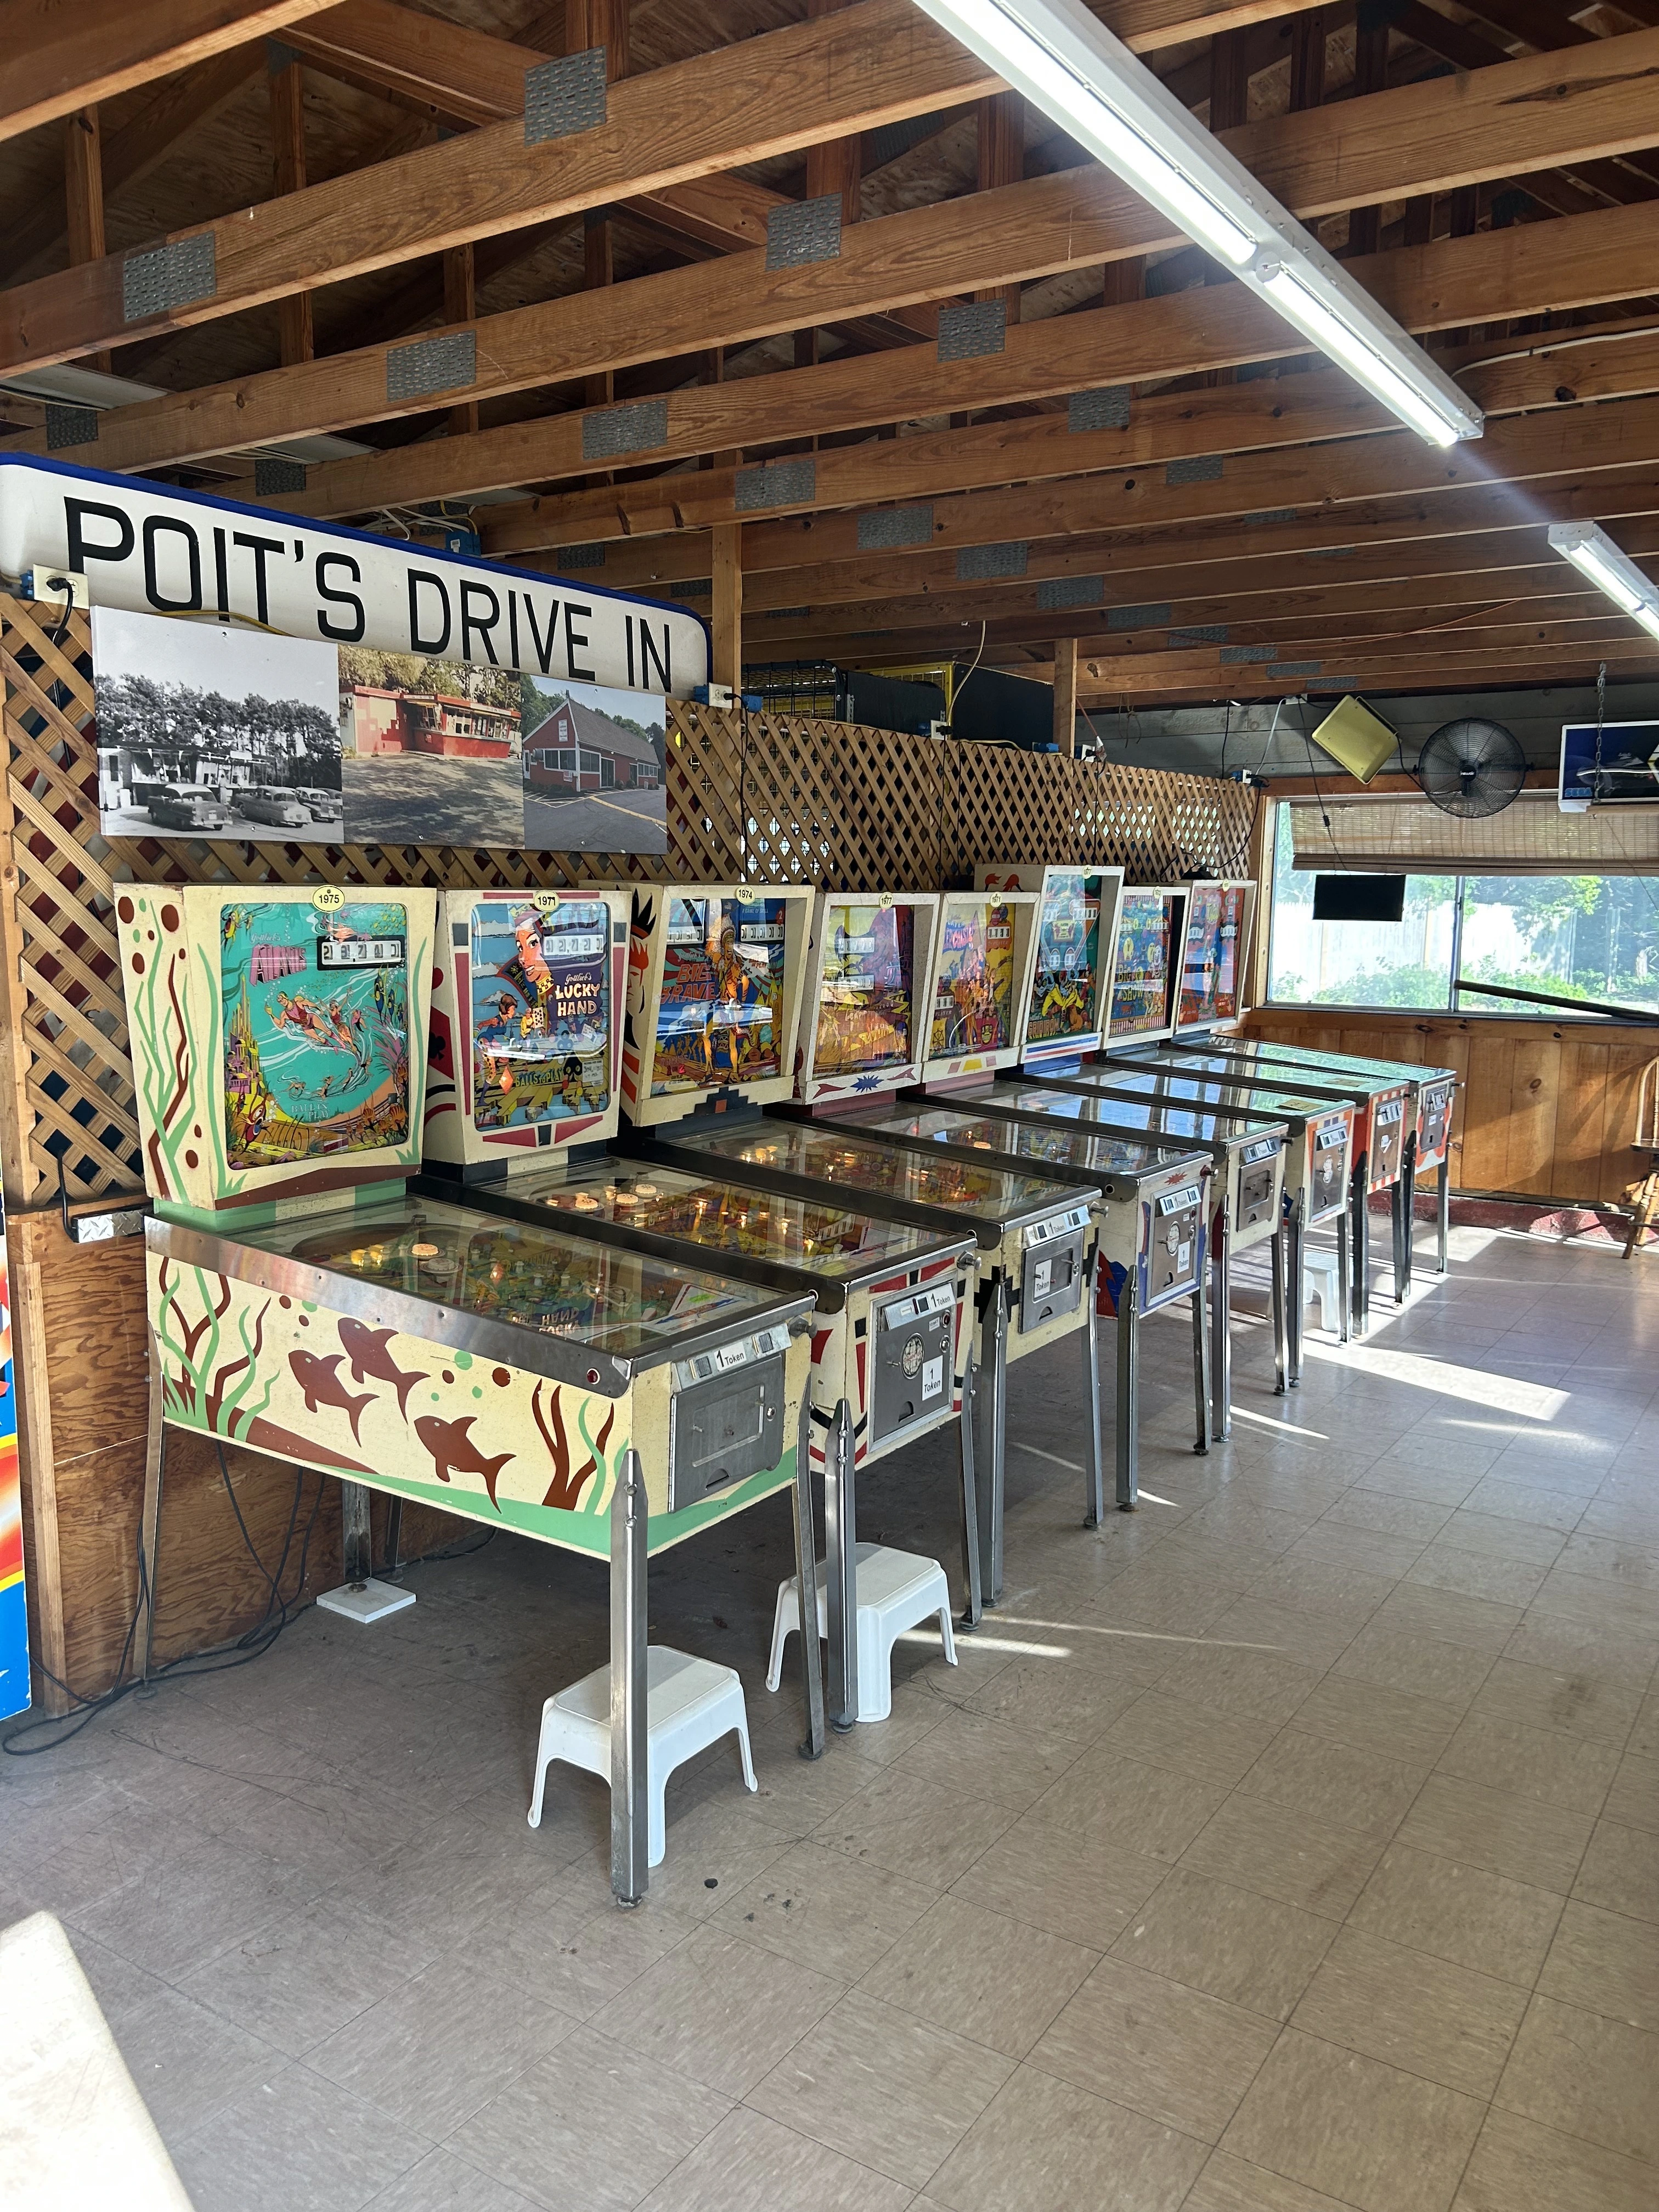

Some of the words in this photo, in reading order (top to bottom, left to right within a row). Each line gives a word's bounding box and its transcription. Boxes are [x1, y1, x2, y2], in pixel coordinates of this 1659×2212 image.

[64, 496, 365, 642] POIT'S
[408, 568, 595, 682] DRIVE
[625, 615, 672, 693] IN
[1565, 787, 1592, 797] SEGA
[319, 895, 339, 903] 1975
[738, 889, 752, 899] 1974
[676, 963, 712, 983] BIG
[555, 983, 600, 1000] LUCKY
[661, 982, 718, 1005] BRAVE
[557, 1000, 597, 1017] HAND
[516, 1074, 538, 1087] BALLS
[546, 1068, 563, 1082] PLAY
[1048, 1222, 1053, 1234] 1
[1053, 1224, 1064, 1232] Token
[1042, 1270, 1045, 1280] 1
[1036, 1280, 1049, 1291] Token
[931, 1293, 937, 1307] 1
[936, 1296, 951, 1306] Token
[716, 1350, 724, 1367] 1
[724, 1352, 744, 1367] Token
[930, 1368, 933, 1379] 1
[924, 1380, 940, 1393] Token
